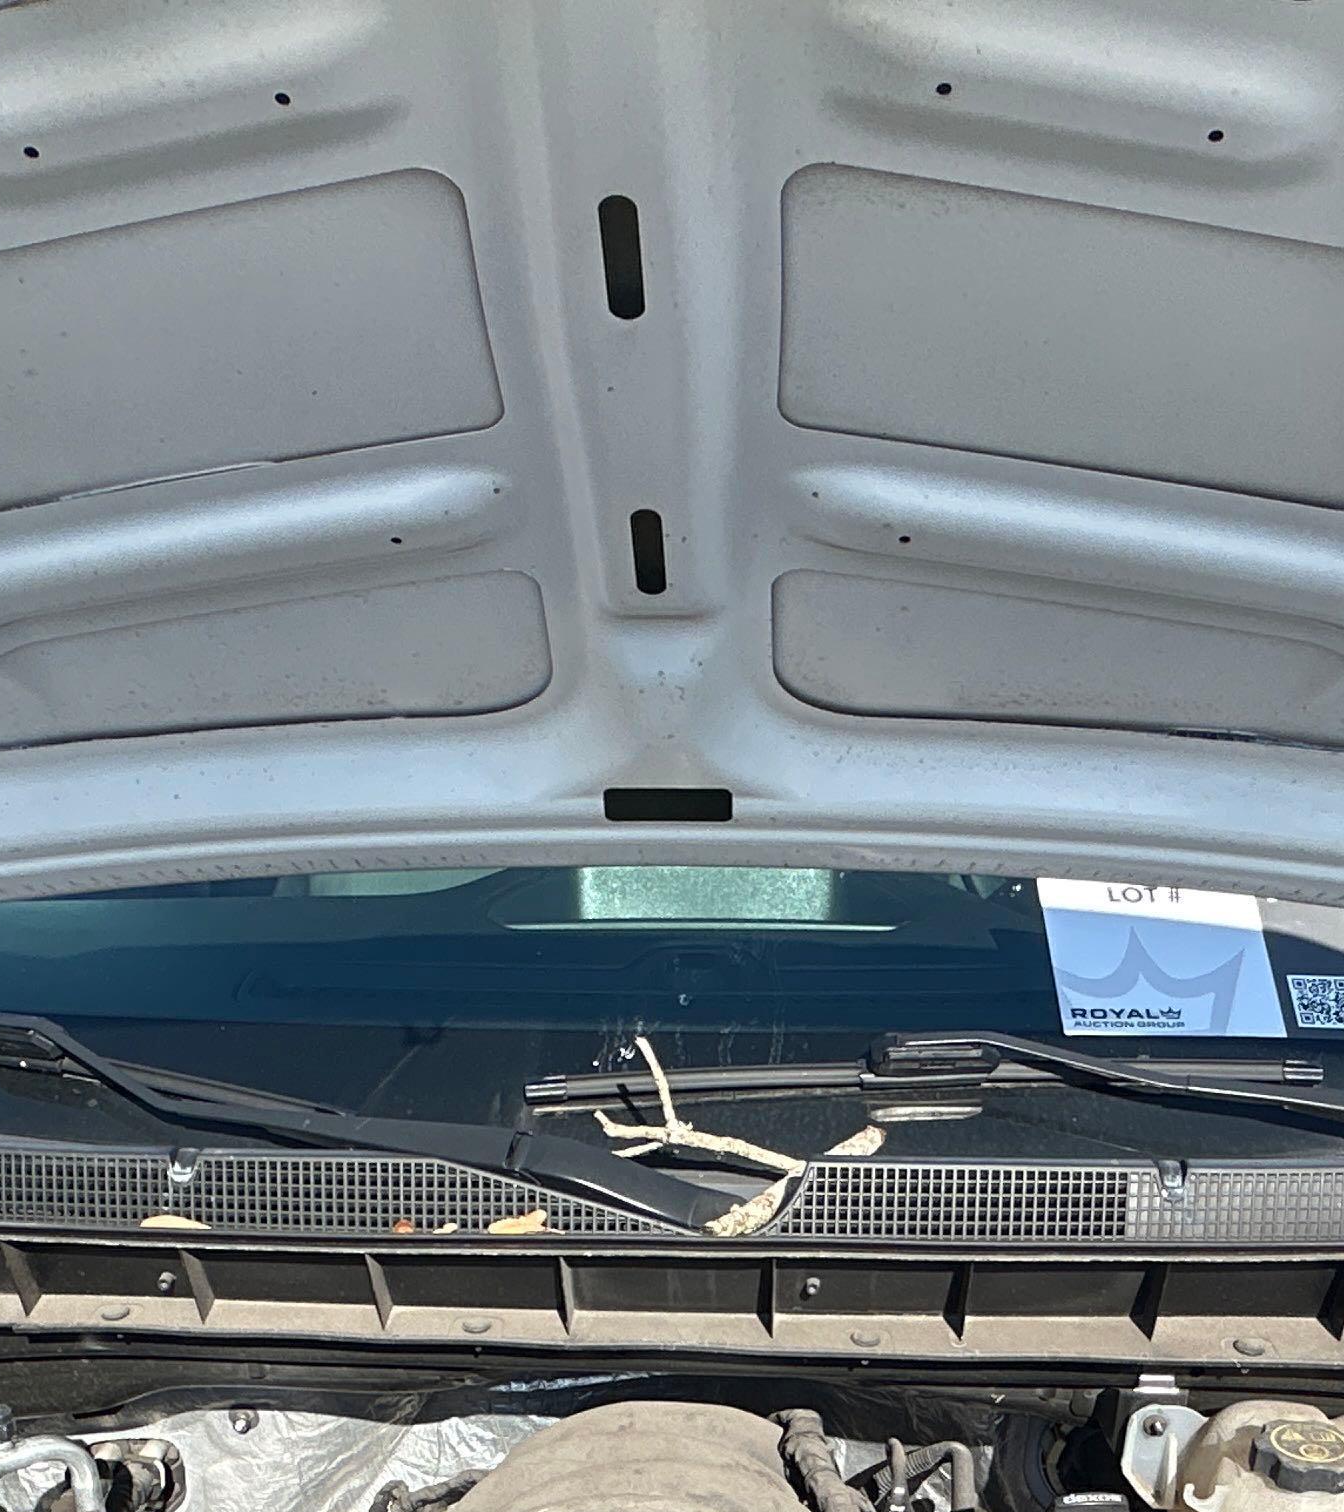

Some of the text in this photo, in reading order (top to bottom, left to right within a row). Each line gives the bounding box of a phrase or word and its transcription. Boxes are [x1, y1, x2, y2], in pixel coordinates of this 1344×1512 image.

[1107, 886, 1181, 904] LOT #
[1071, 1008, 1160, 1020] ROYAL
[1074, 1021, 1185, 1029] AUCTION GROUP
